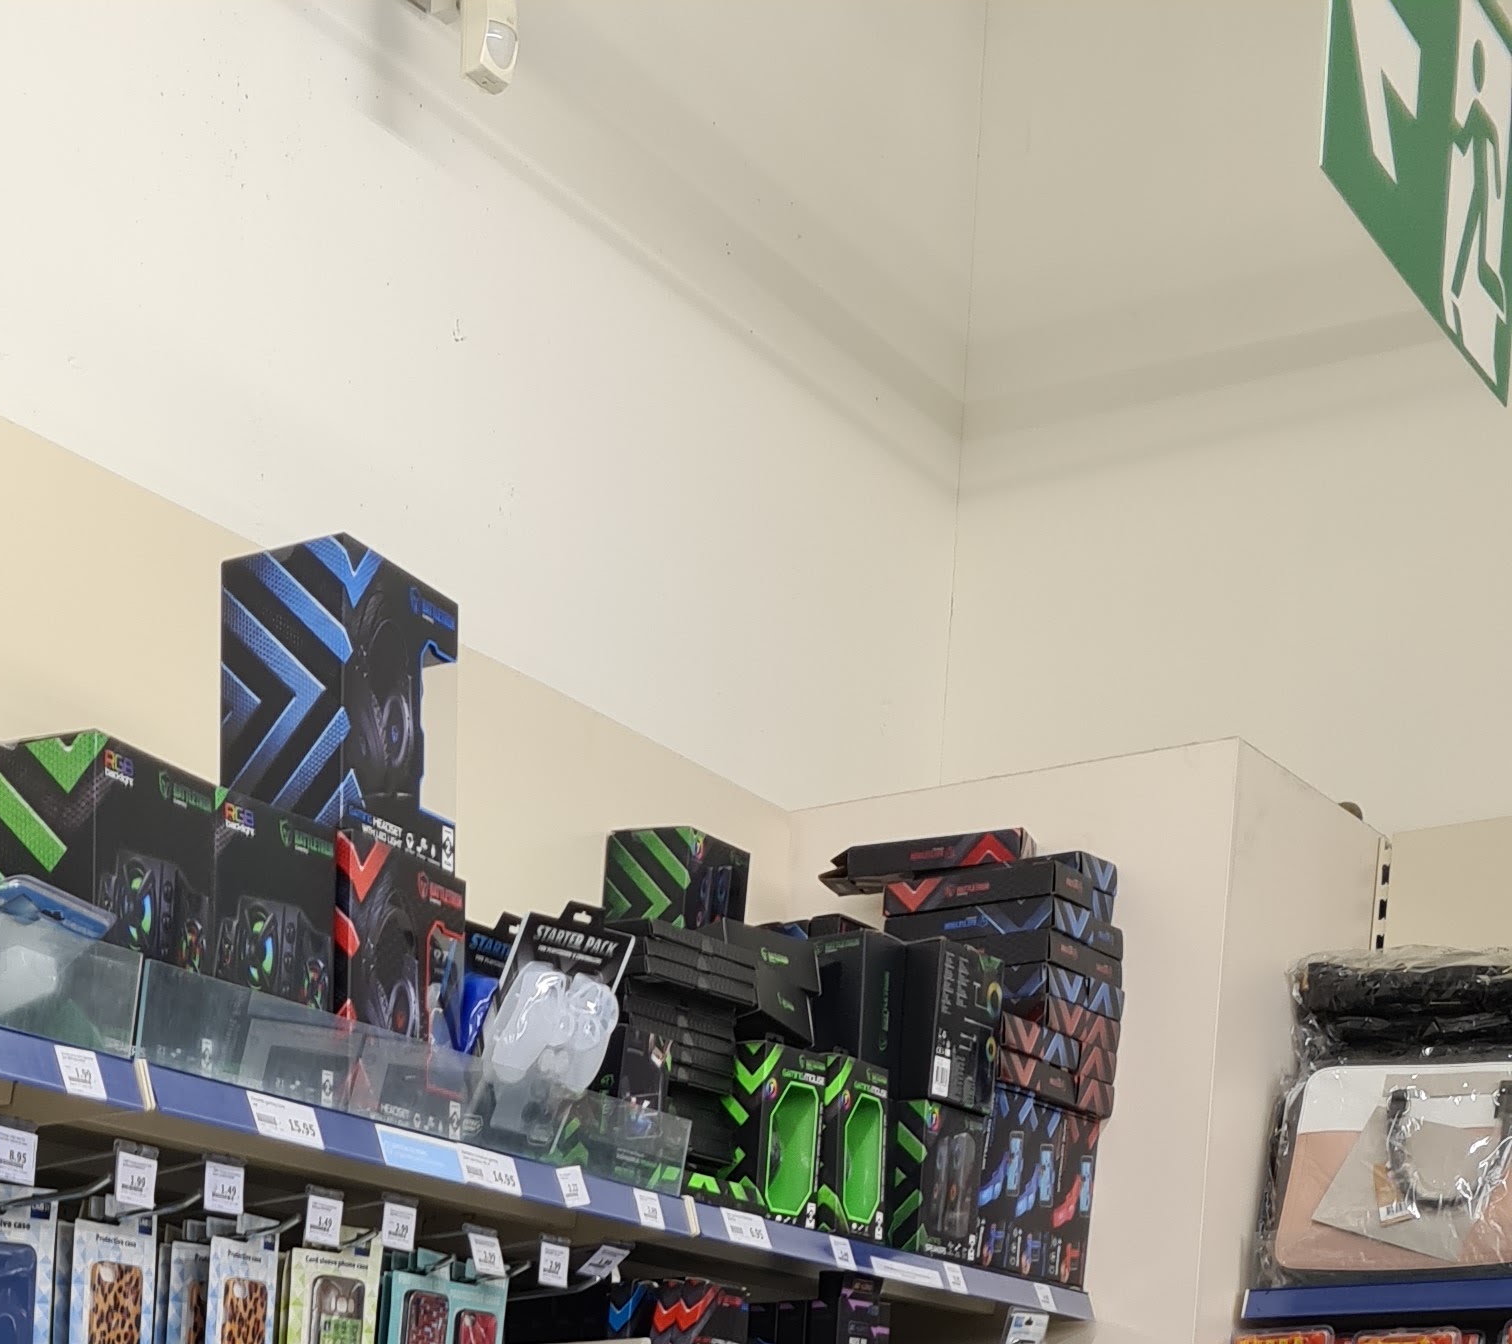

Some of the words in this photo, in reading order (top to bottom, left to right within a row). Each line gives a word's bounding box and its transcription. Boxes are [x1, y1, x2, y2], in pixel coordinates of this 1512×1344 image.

[105, 749, 134, 776] RGB
[224, 802, 255, 828] RGB
[534, 925, 584, 949] STARTER
[584, 934, 619, 957] PACK
[9, 1149, 27, 1165] 8.95
[96, 1233, 125, 1247] Protective
[125, 1239, 137, 1248] case
